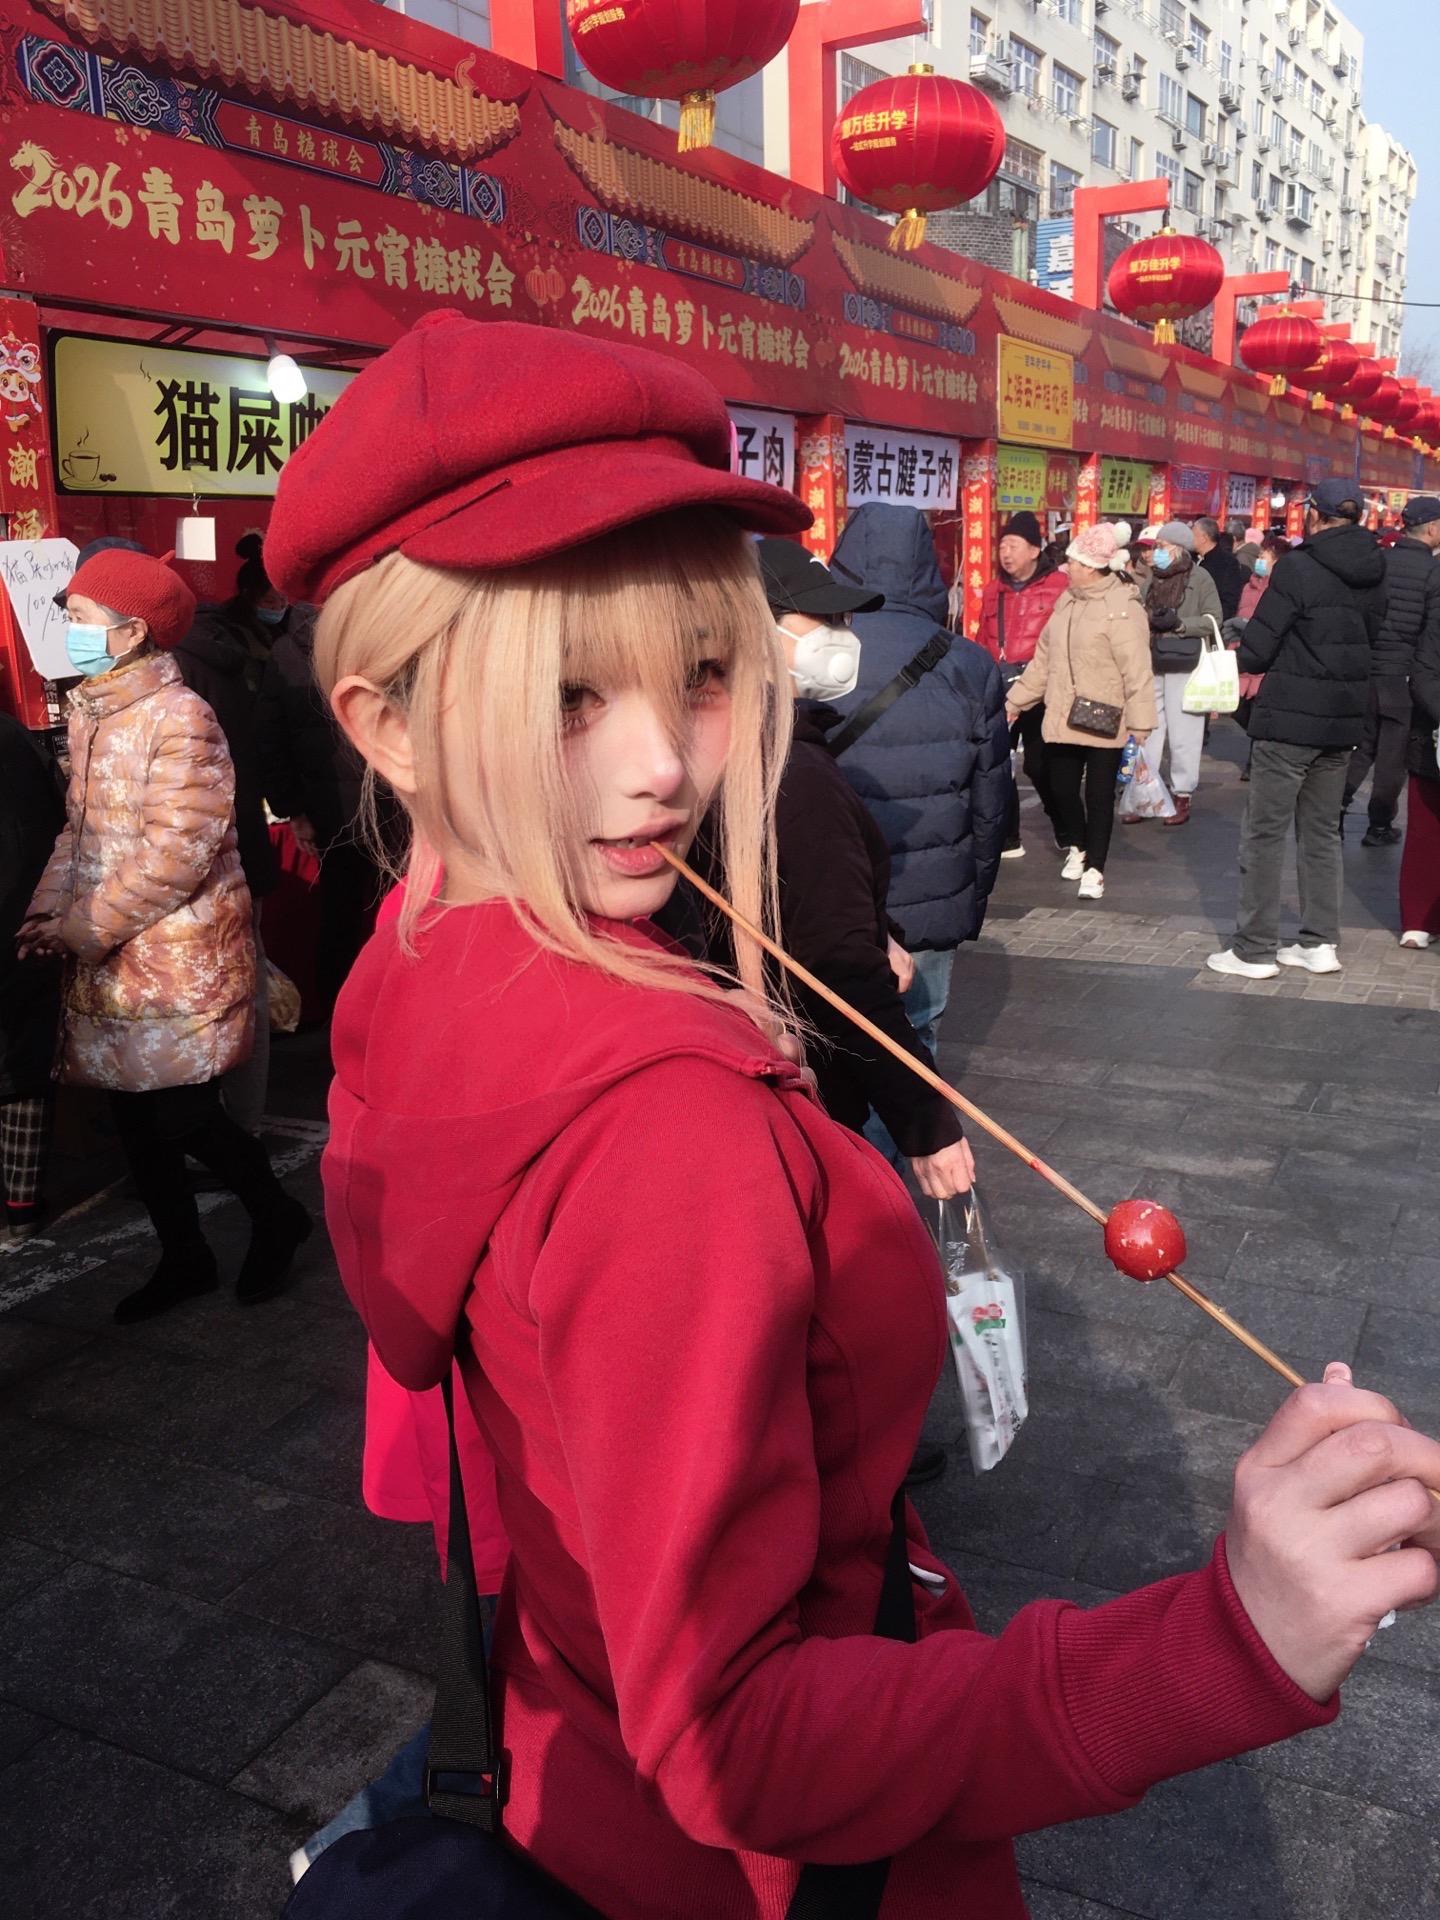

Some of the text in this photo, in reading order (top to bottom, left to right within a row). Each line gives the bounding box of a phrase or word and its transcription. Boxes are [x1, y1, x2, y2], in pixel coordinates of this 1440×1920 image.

[244, 113, 366, 176] 青岛糖球会
[9, 139, 516, 308] 2026青岛萝卜元宵糖球会
[675, 246, 737, 281] 青岛糖球会
[570, 273, 811, 369] 2026青岛萝卜元宵糖球会
[839, 342, 978, 404] 2026青岛萝卜元宵糖球会
[845, 439, 953, 499] 蒙古腱子肉
